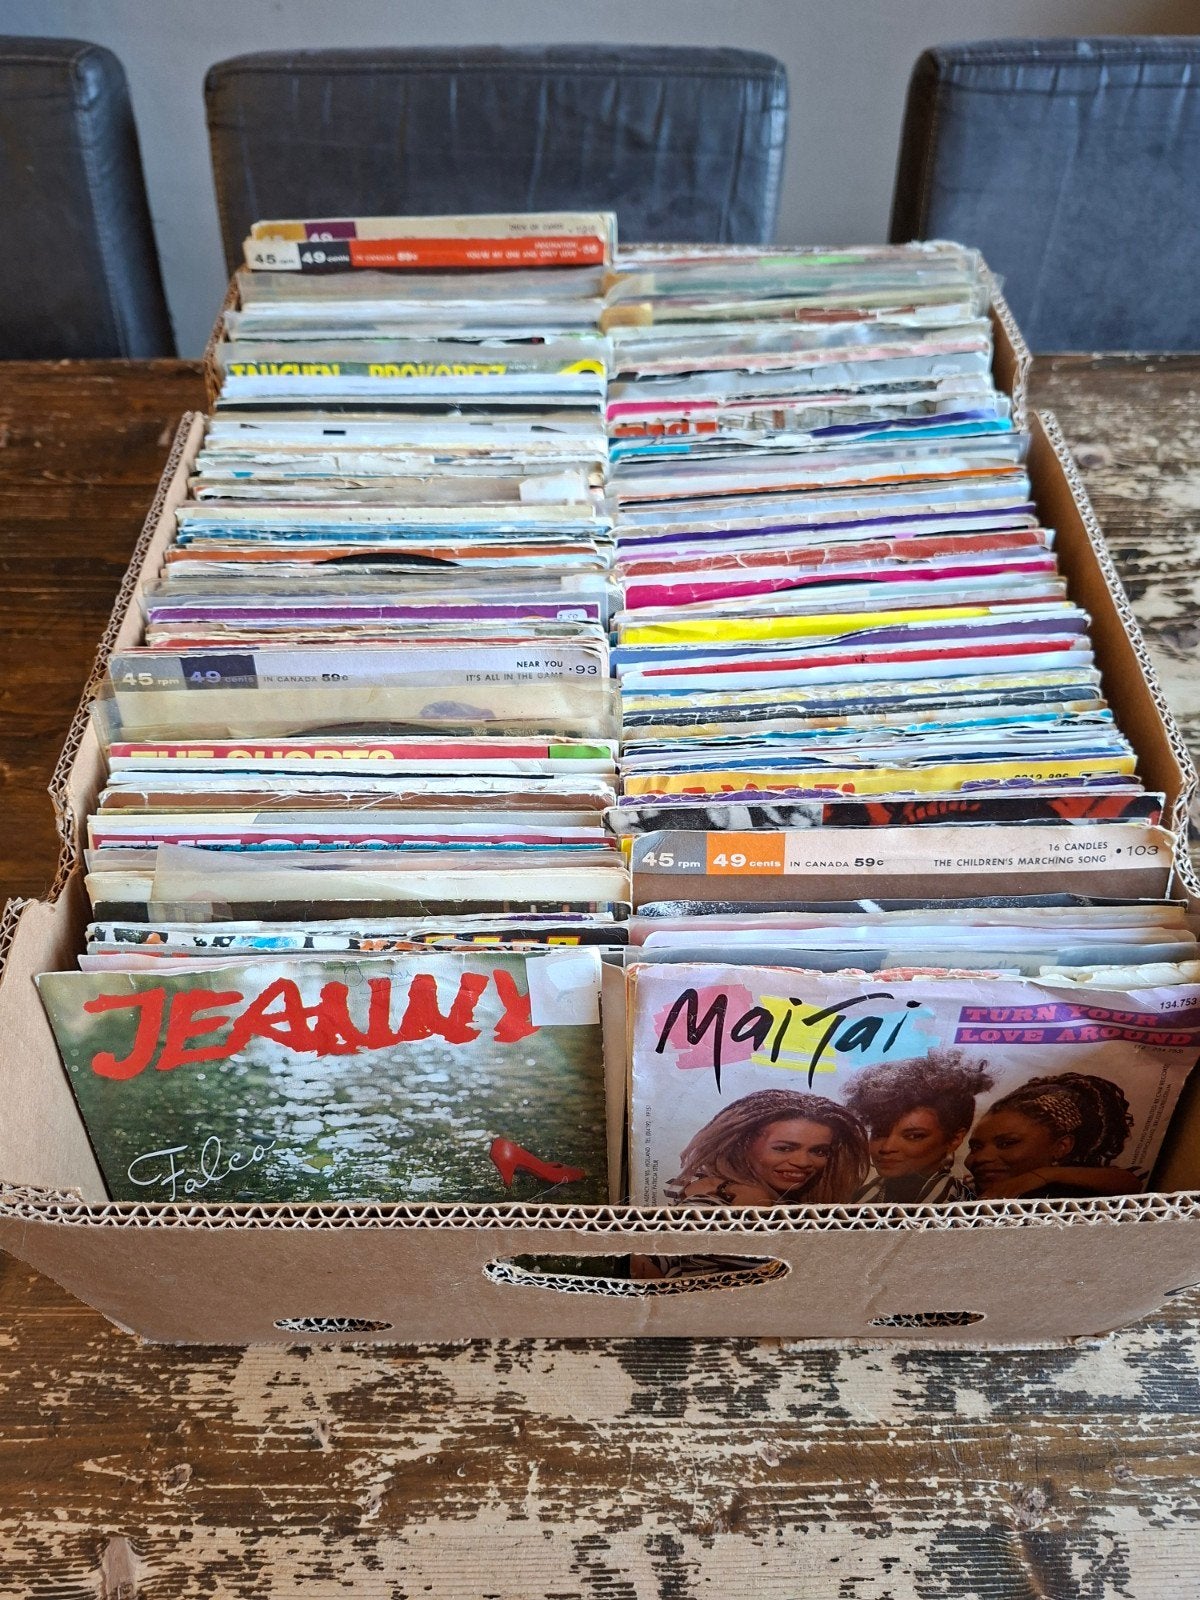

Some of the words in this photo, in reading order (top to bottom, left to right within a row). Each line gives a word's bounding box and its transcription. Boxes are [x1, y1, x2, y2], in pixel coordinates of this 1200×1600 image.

[302, 251, 326, 264] 49
[516, 660, 540, 668] NEAR
[545, 660, 563, 668] YOU
[575, 665, 597, 675] 93
[122, 672, 153, 686] 45
[157, 678, 180, 687] rpm
[190, 670, 221, 683] 49
[225, 675, 255, 684] cents
[466, 674, 481, 682] IT'S
[485, 673, 500, 682] ALL
[504, 673, 513, 681] IN
[518, 672, 533, 680] THE
[1049, 843, 1060, 852] 16
[1064, 841, 1108, 852] CANDLES
[1127, 845, 1159, 856] 103
[641, 853, 674, 867] 45
[678, 859, 701, 869] rpm
[712, 853, 747, 867] 49
[749, 859, 781, 868] cents
[805, 860, 849, 868] CANADA
[854, 857, 884, 867] 59c
[934, 859, 952, 867] THE
[956, 857, 1013, 867] CHILDREN'S
[1018, 855, 1074, 865] MARCHING
[1078, 854, 1106, 864] SONG
[1160, 997, 1197, 1010] 134.753
[966, 1005, 1056, 1022] TURN
[1069, 1003, 1159, 1026] YOUR
[960, 1028, 1043, 1042] LOVE
[1056, 1023, 1192, 1045] AROUND
[655, 988, 802, 1094] Mai
[127, 1136, 276, 1201] Falco
